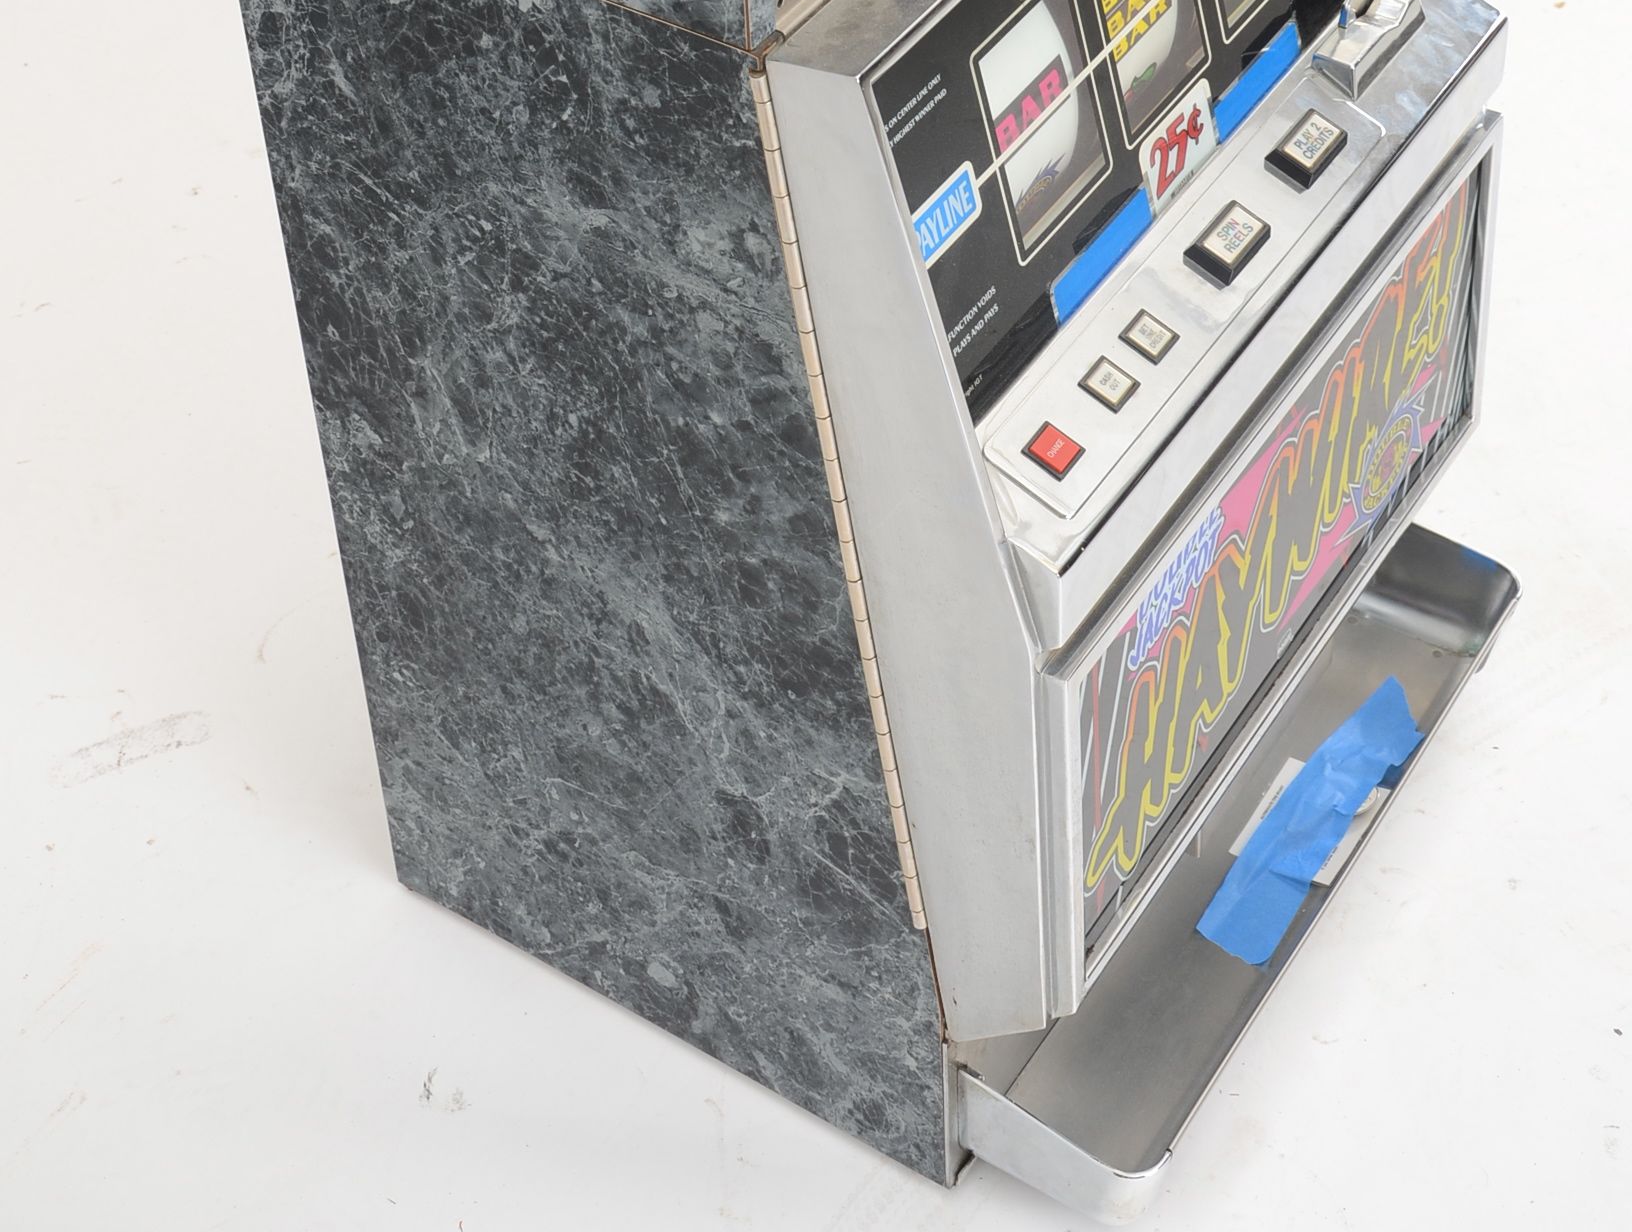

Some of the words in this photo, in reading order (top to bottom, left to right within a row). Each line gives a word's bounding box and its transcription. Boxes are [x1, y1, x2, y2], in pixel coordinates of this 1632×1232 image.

[888, 116, 898, 128] ON
[896, 97, 917, 120] CENTER
[916, 86, 928, 101] LINE
[928, 73, 941, 90] ONLY
[893, 118, 916, 144] HIGHEST
[914, 99, 935, 122] WINNER
[995, 67, 1062, 154] BAR
[1150, 102, 1204, 200] 25¢
[1294, 129, 1313, 150] PLAY
[1310, 122, 1321, 131] 2
[1302, 127, 1334, 159] CREDITS
[914, 180, 973, 256] AYLINE
[1216, 218, 1240, 242] SPIN
[1224, 223, 1254, 253] REELS
[947, 304, 979, 343] FUNCTION
[977, 285, 997, 308] VOIDS
[953, 333, 971, 357] PLAYS
[971, 319, 984, 338] AND
[984, 303, 999, 323] PAYS
[1047, 438, 1065, 458] CHANGE
[1128, 515, 1224, 670] JACKPOT
